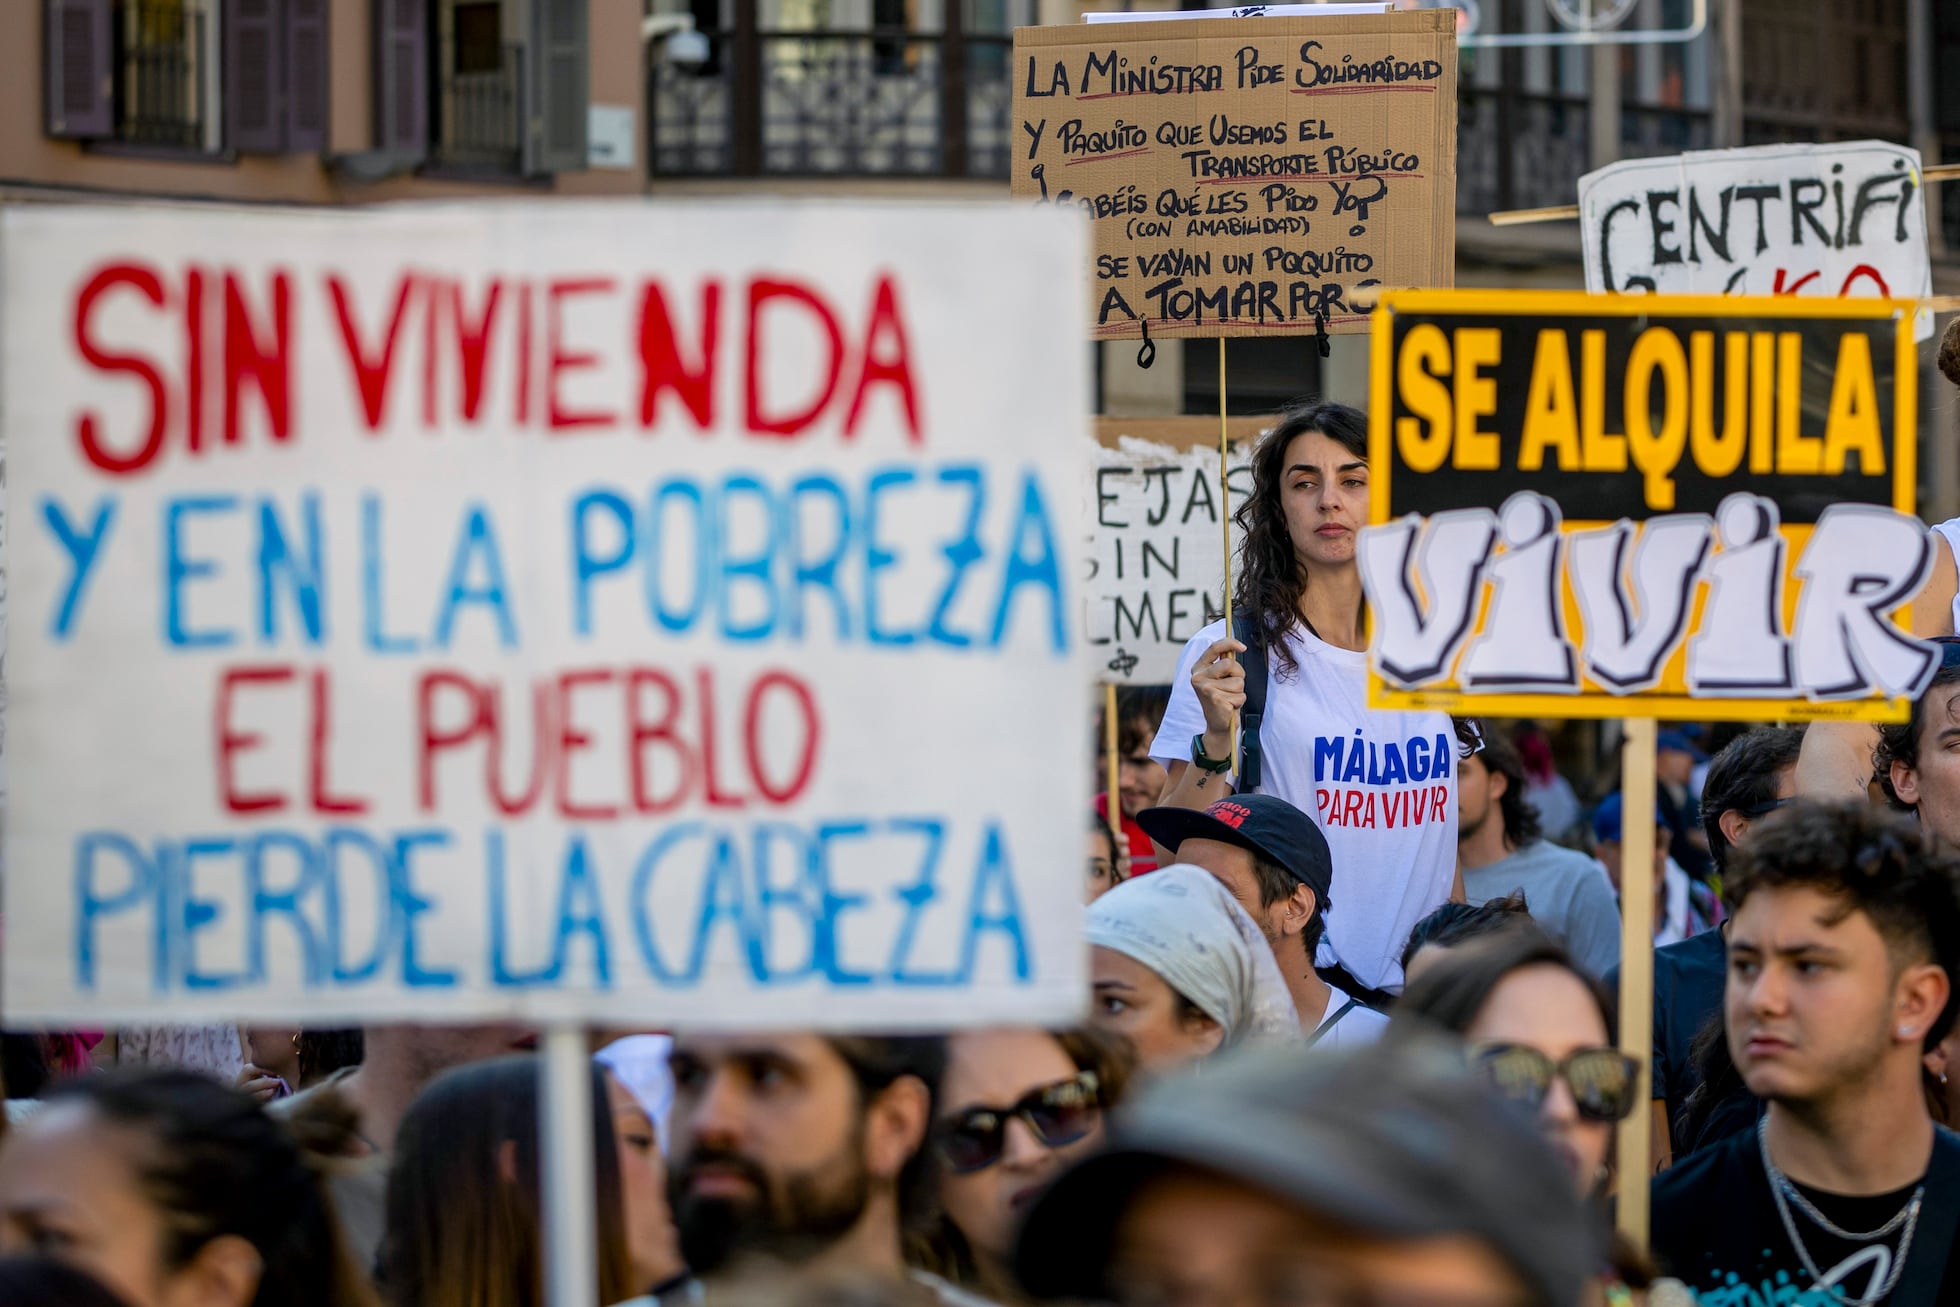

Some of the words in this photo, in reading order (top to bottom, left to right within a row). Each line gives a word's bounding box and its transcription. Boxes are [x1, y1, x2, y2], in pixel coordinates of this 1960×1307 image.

[1026, 55, 1070, 97] LA
[1023, 118, 1046, 159] Y
[1155, 121, 1203, 148] QUE
[1209, 115, 1287, 146] USEMOS
[1299, 119, 1334, 142] EL
[1181, 150, 1319, 178] TRANSPORTE
[1206, 190, 1248, 215] LES
[1126, 217, 1171, 240] (CON
[1097, 254, 1129, 279] SE
[1136, 248, 1211, 278] VAYAN
[1223, 252, 1252, 275] UN
[1098, 286, 1136, 324] A
[1145, 278, 1284, 323] TOMAR
[1290, 281, 1347, 322] POR
[69, 256, 294, 477] SIN
[325, 267, 924, 449] VIVIENDA
[1396, 324, 1501, 473] SE
[1517, 327, 1886, 510] ALQUILA
[37, 490, 119, 643] Y
[163, 490, 328, 650] EN
[363, 492, 519, 652] LA
[569, 459, 1070, 660] POBREZA
[216, 664, 369, 815] EL
[417, 664, 820, 819] PUEBLO
[1314, 729, 1449, 785] MÁLAGA
[1316, 789, 1376, 829] PARA
[1382, 785, 1448, 829] VIVIR
[74, 829, 455, 992] PIERDE
[488, 825, 613, 990] LA
[629, 815, 1034, 990] CABEZA
